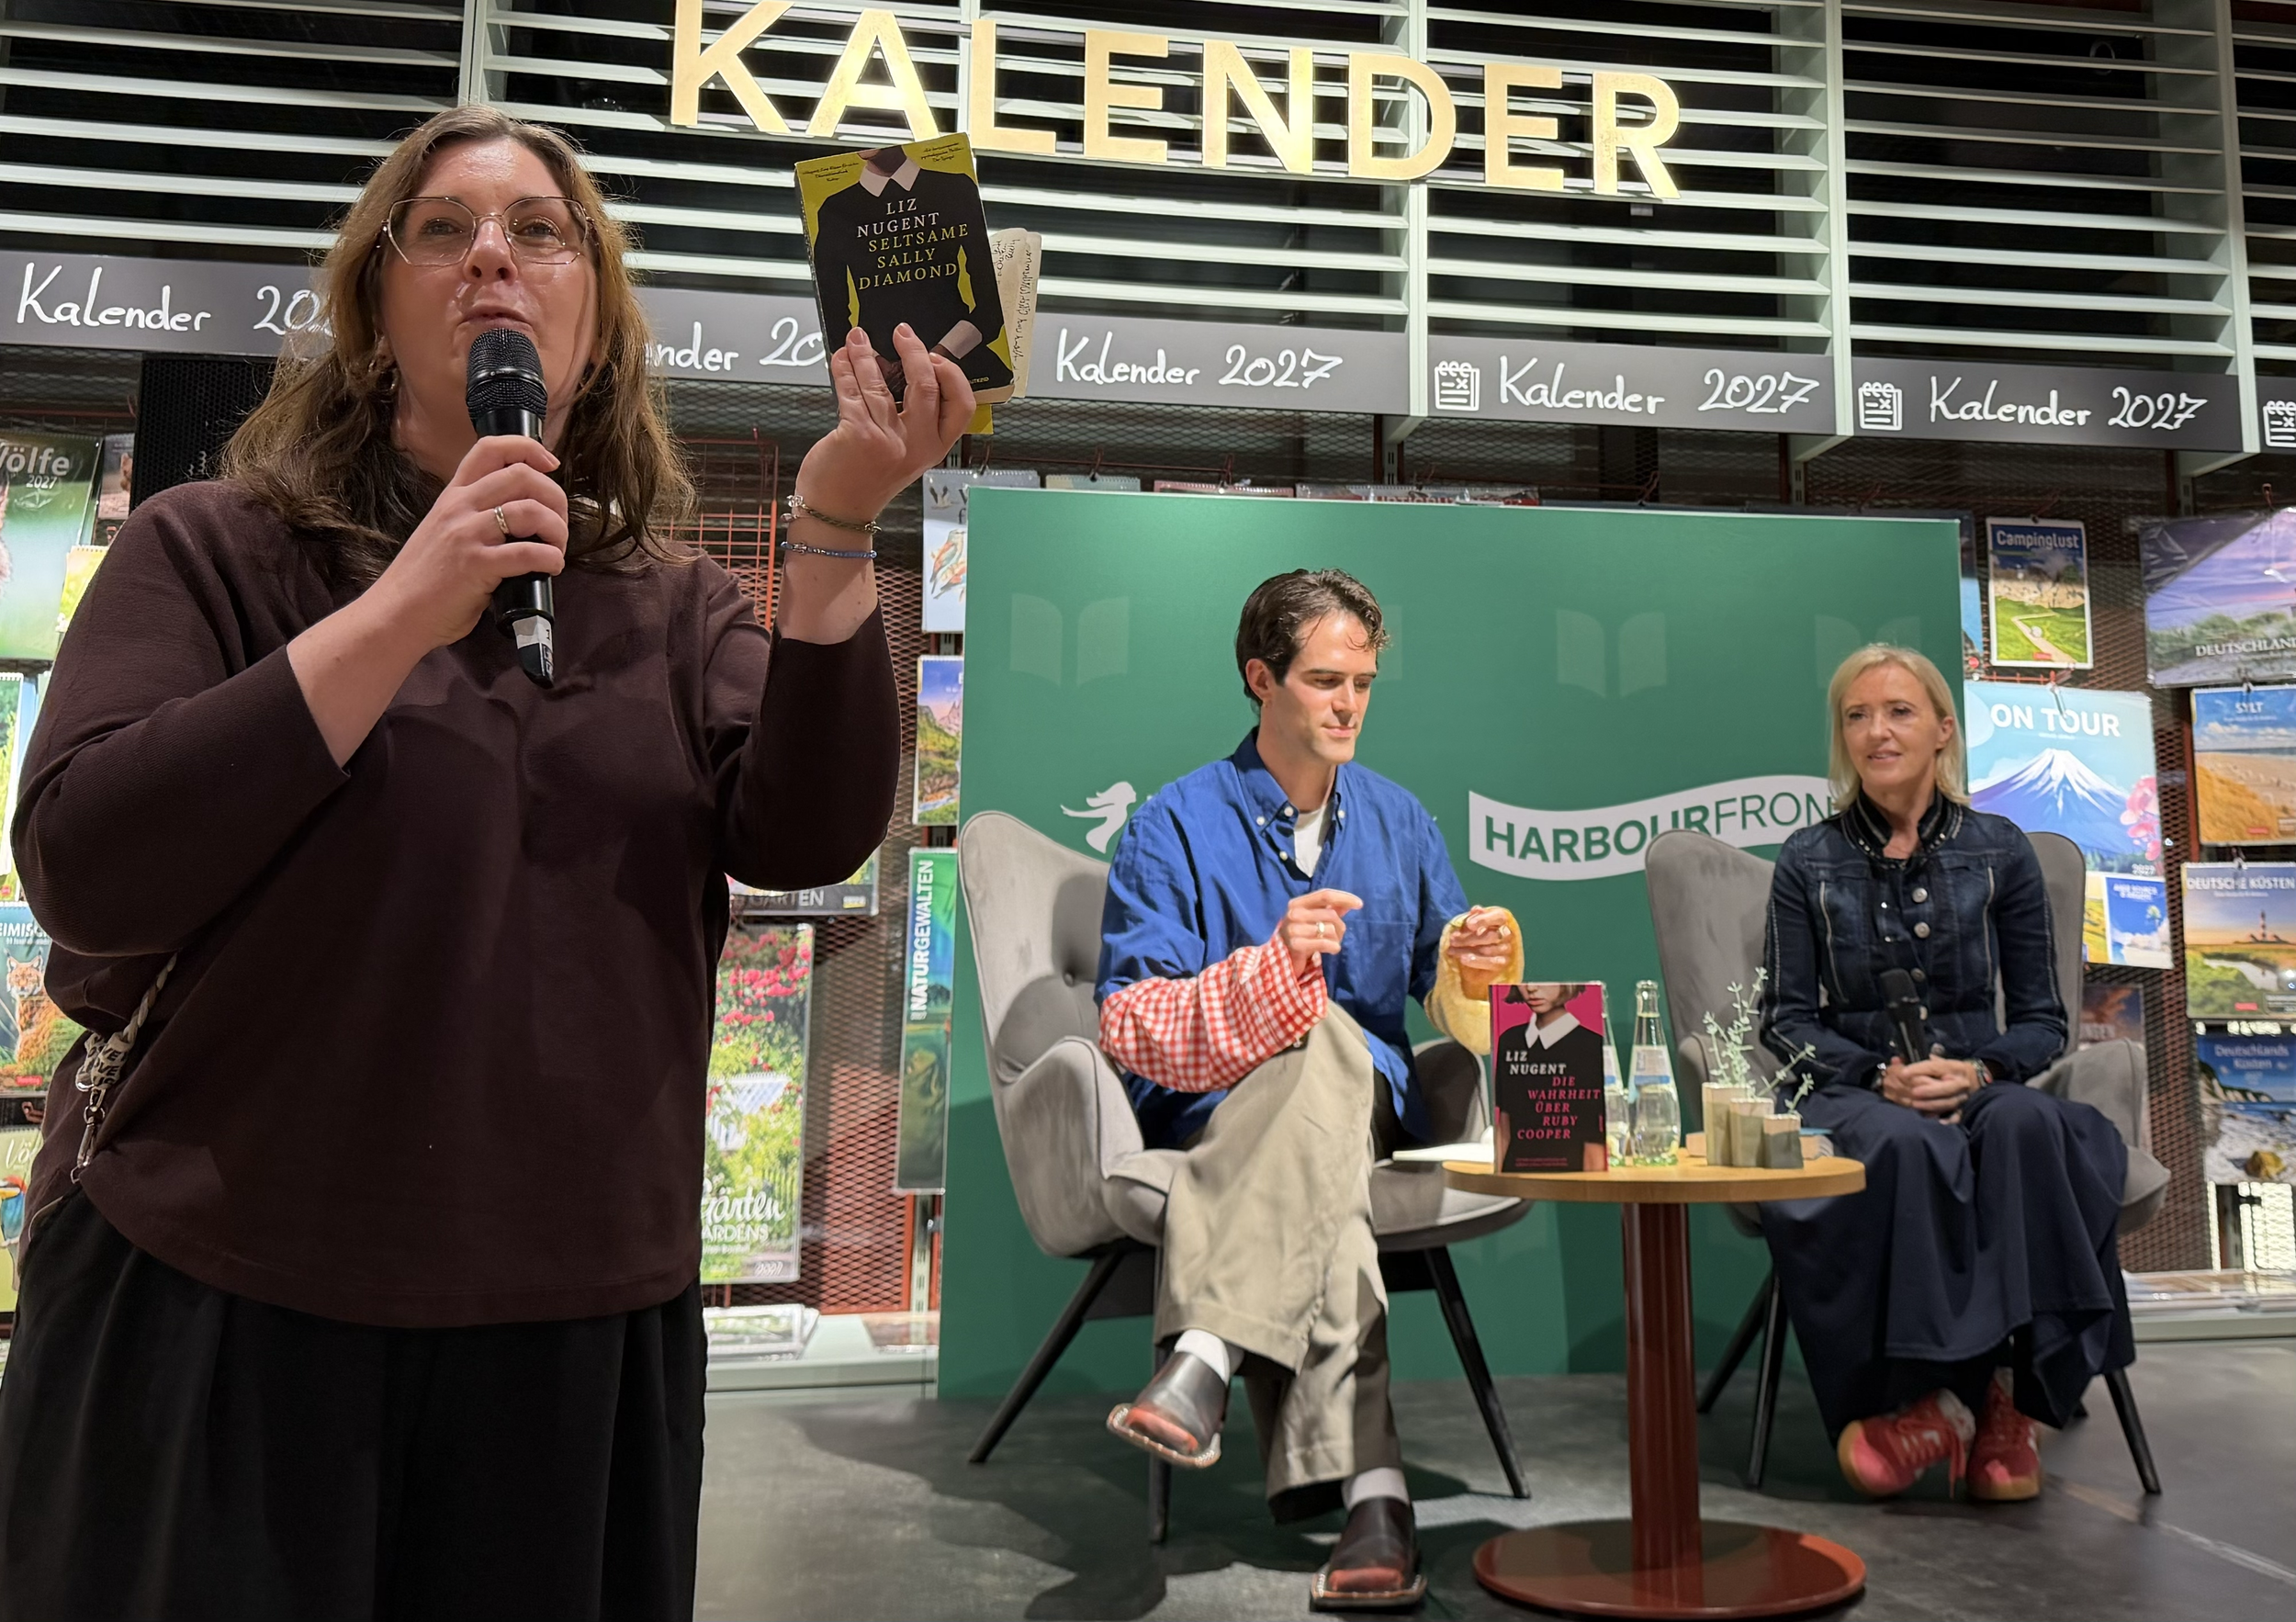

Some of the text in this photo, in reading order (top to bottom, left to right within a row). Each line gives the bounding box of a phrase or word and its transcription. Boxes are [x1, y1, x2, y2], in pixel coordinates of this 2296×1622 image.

[670, 0, 1682, 199] KALENDER
[886, 197, 917, 216] LIZ
[856, 212, 940, 238] NUGENT
[868, 223, 969, 253] SELTSAME
[877, 247, 936, 269] SALLY
[859, 263, 957, 290] DIAMOND
[17, 262, 336, 337] Kalender 20
[646, 317, 827, 371] nder 20
[1056, 327, 1344, 389] Kalender 2027
[1500, 355, 1820, 414] Kalender 2027
[1930, 376, 2209, 430] Kalender 2027
[26, 474, 57, 489] 2027
[1996, 530, 2079, 548] Campinglust
[2234, 701, 2264, 715] SYLT
[1990, 704, 2121, 738] ON TOUR
[1485, 792, 1833, 863] HARBOURFRON
[2249, 875, 2295, 890] KÜSTEN
[909, 859, 934, 1010] NATURGEWALTEN
[1504, 1051, 1528, 1063] LIZ
[2214, 1042, 2290, 1057] Deutschlands
[1509, 1063, 1567, 1076] NUGENT
[1552, 1076, 1576, 1087] DIE
[1527, 1089, 1602, 1101] WAHRHEIT
[1535, 1101, 1570, 1114] ÜBER
[1542, 1115, 1579, 1127] RUBY
[1517, 1128, 1571, 1140] COOPER
[702, 1224, 769, 1243] ARDENS
